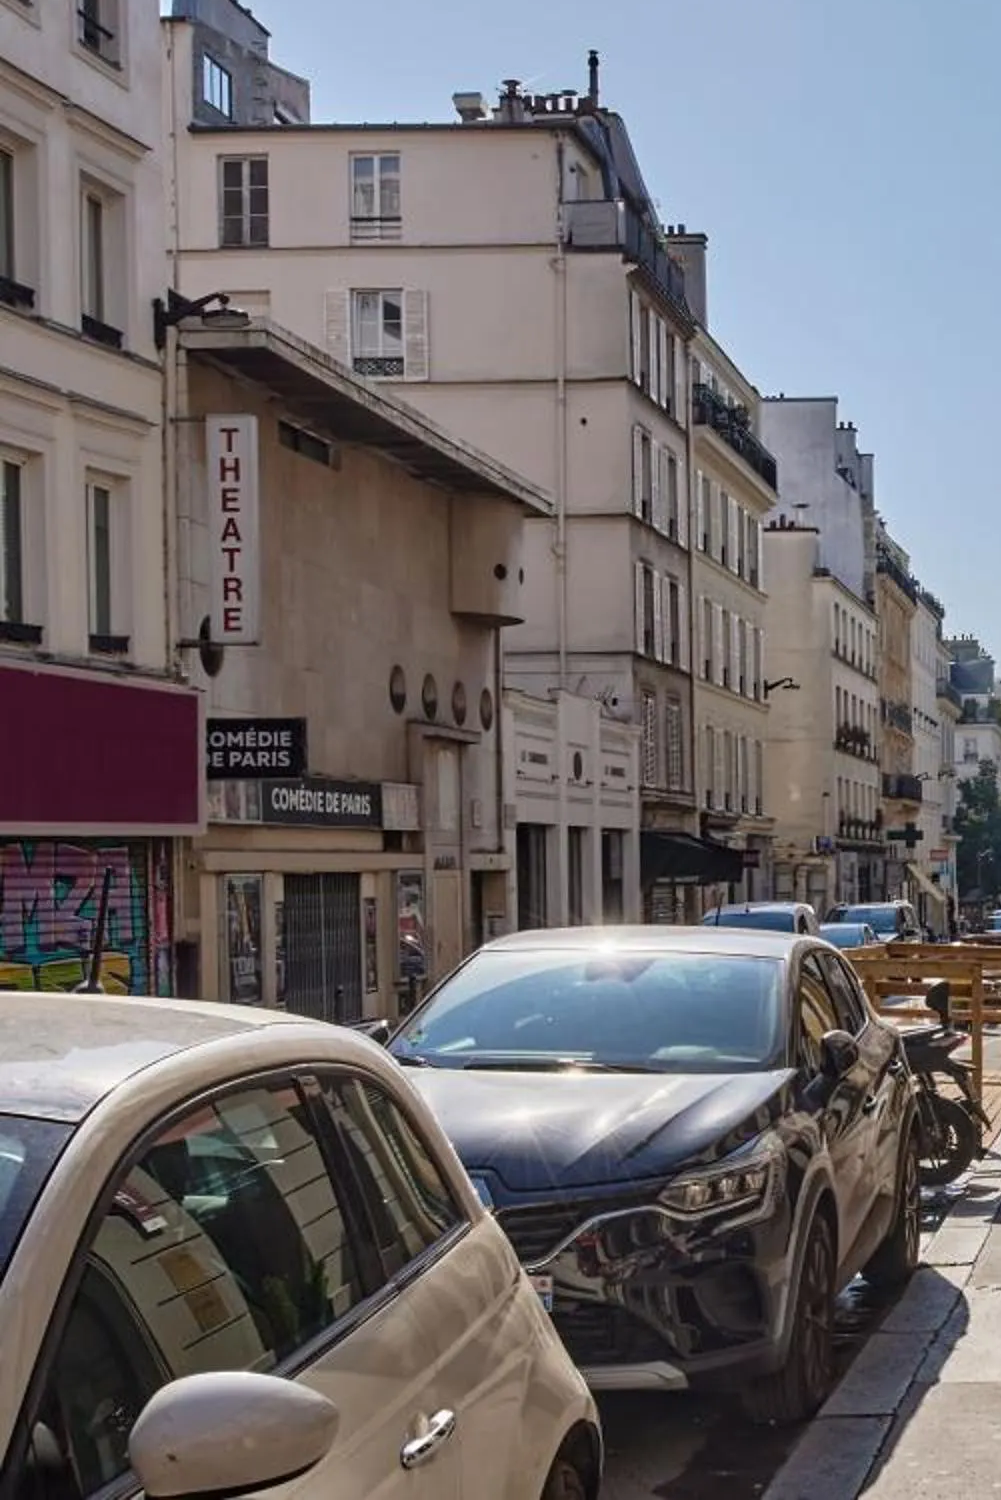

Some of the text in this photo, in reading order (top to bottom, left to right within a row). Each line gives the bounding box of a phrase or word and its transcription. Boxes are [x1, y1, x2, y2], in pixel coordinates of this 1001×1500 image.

[218, 426, 243, 633] THEATRE
[207, 727, 293, 748] OMÉDIE
[228, 750, 291, 768] PARIS
[271, 784, 372, 816] COMÉDIE DE PARIS
